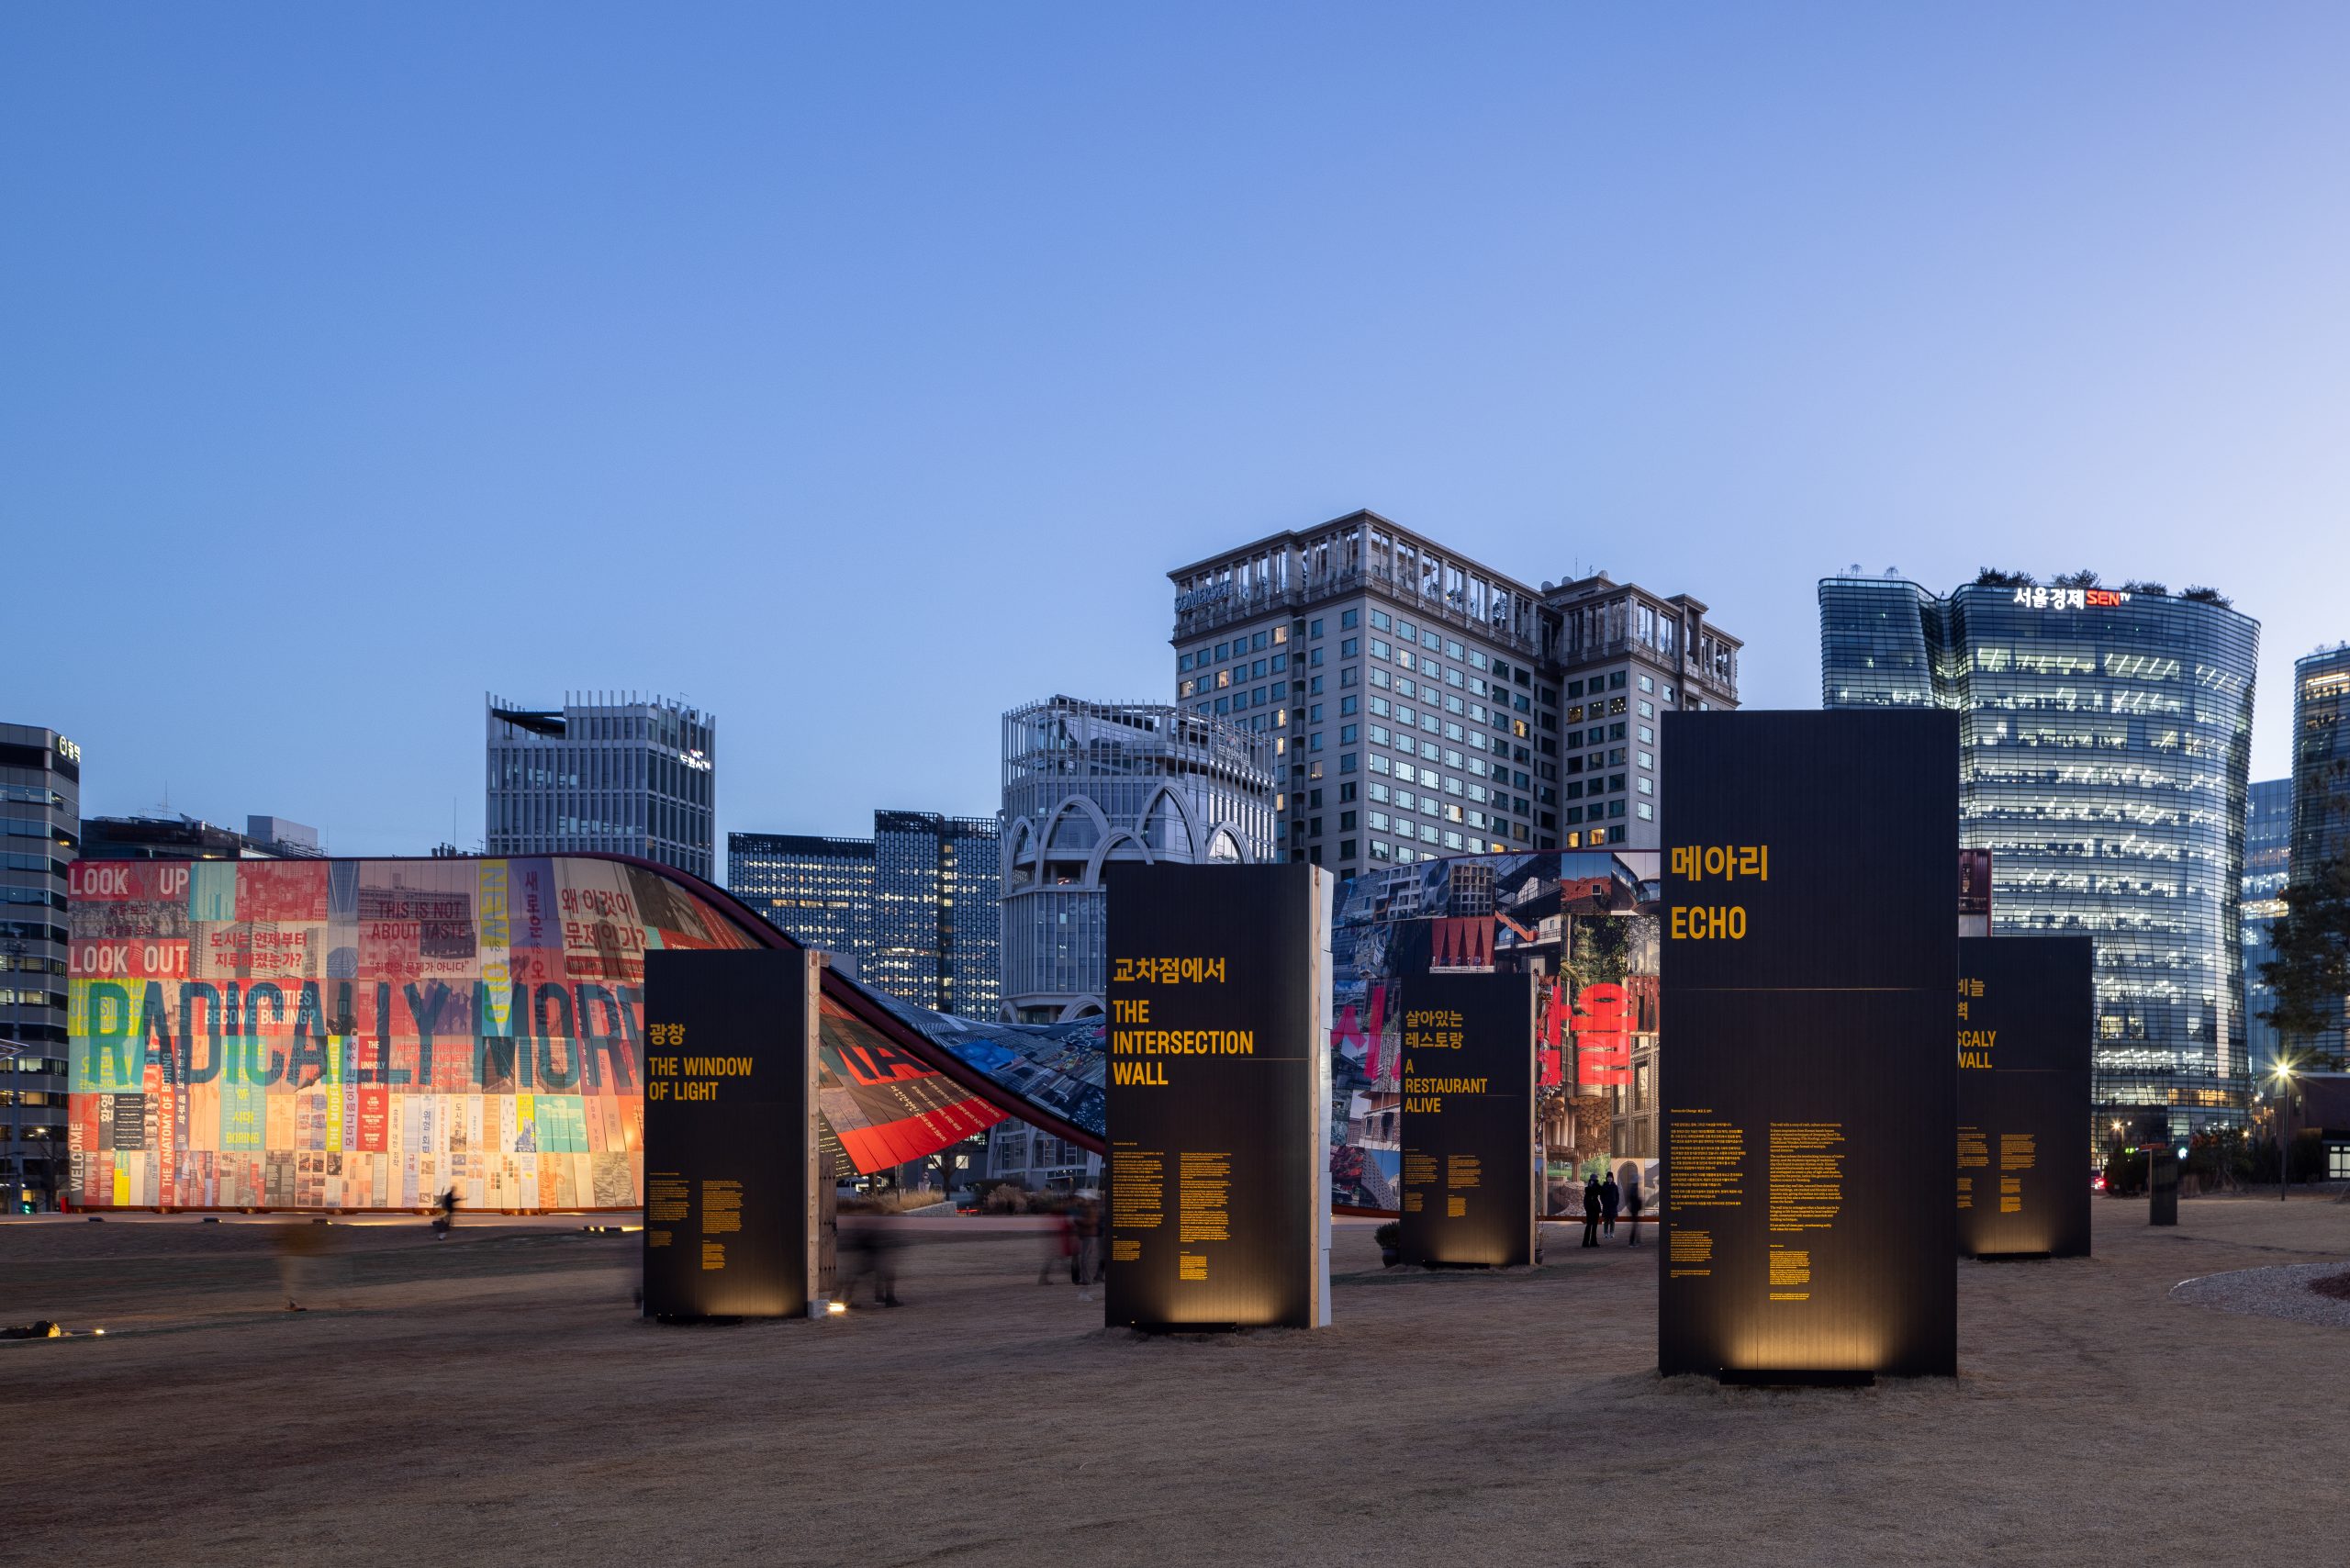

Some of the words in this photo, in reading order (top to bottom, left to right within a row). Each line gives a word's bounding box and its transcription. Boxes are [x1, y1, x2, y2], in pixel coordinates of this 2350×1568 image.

[2014, 588, 2084, 610] 서울경제
[2086, 590, 2120, 607] SEN
[1671, 845, 1768, 881] 메아리
[70, 868, 129, 895] LOOK
[160, 868, 189, 895] UP
[378, 902, 409, 918] THIS
[416, 902, 428, 918] IS
[433, 902, 461, 918] NOT
[482, 867, 508, 939] NEW
[525, 870, 543, 939] 새로운
[561, 888, 579, 914] 왜
[582, 889, 634, 919] 이것이
[372, 923, 420, 939] ABOUT
[424, 923, 463, 937] TASTE
[1671, 905, 1747, 940] ECHO
[210, 932, 251, 947] 도시는
[254, 932, 308, 949] 언제부터
[488, 940, 503, 953] VS.
[565, 922, 646, 952] 문제인가?
[531, 941, 543, 955] VS.
[70, 946, 129, 973] LOOK
[144, 946, 188, 973] OUT
[215, 953, 302, 969] 지루해졌는가?
[405, 961, 433, 973] 문제가
[1113, 957, 1225, 984] 교차점에서
[206, 990, 244, 1006] WHEN
[248, 990, 269, 1006] DID
[273, 990, 312, 1006] CITIES
[482, 963, 510, 1023] OLD
[72, 998, 143, 1017] OUTSIDES
[206, 1009, 256, 1025] BECOME
[261, 1009, 317, 1025] BORING?
[1113, 999, 1149, 1024] THE
[1405, 1010, 1463, 1028] 살아있는
[89, 979, 451, 1088] RADICALLY
[649, 1023, 686, 1046] 광창
[1113, 1030, 1254, 1055] INTERSECTION
[1405, 1032, 1463, 1049] 레스토랑
[304, 1047, 321, 1057] YEAR
[368, 1040, 380, 1049] THE
[273, 1058, 321, 1067] CATASTROPHE
[330, 1042, 341, 1069] CULT
[361, 1061, 386, 1070] UNHOLY
[1404, 1058, 1415, 1073] A
[162, 1053, 173, 1092] BORING
[649, 1057, 678, 1076] THE
[683, 1057, 753, 1076] WINDOW
[1113, 1061, 1169, 1086] WALL
[361, 1081, 385, 1090] TRINITY
[649, 1081, 669, 1101] OF
[675, 1081, 719, 1101] LIGHT
[1404, 1078, 1487, 1093] RESTAURANT
[162, 1096, 173, 1111] OF
[330, 1071, 340, 1121] MODERN
[1404, 1097, 1441, 1113] ALIVE
[100, 1094, 115, 1123] 환영
[346, 1070, 356, 1147] 모더니즘이라는
[162, 1113, 172, 1165] ANATOMY
[226, 1132, 260, 1144] BORING
[329, 1126, 339, 1146] THE
[70, 1123, 84, 1192] WELCOME
[162, 1170, 172, 1188] THE
